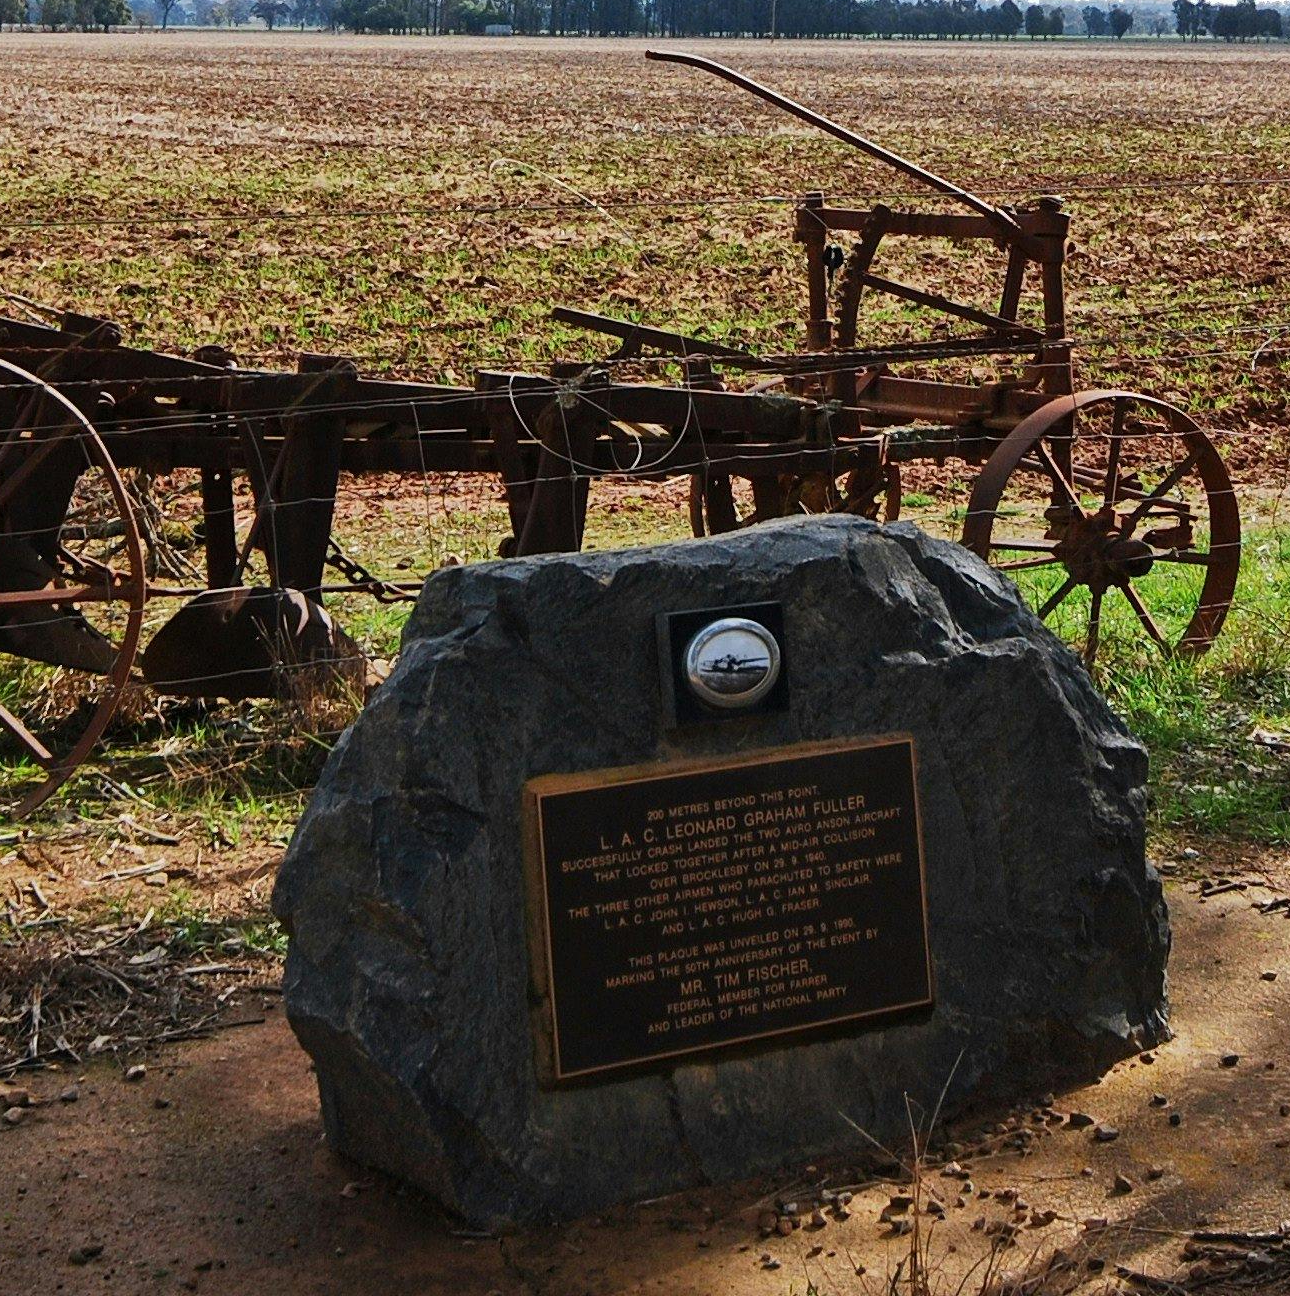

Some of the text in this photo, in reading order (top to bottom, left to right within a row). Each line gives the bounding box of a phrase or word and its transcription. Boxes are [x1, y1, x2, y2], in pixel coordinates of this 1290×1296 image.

[647, 810, 664, 820] 200
[761, 791, 783, 802] THIS
[666, 816, 736, 839] LEONARD
[744, 805, 805, 826] GRAHAM
[814, 795, 865, 815] FULLER
[562, 850, 642, 872] SUCCESSFULLY
[648, 844, 682, 858] CRASH
[688, 836, 728, 851] LANDED
[734, 832, 753, 843] THE
[759, 828, 780, 839] TWO
[817, 817, 850, 830] ANSON
[855, 808, 900, 824] AIRCRAFT
[595, 870, 621, 882] THAT
[627, 862, 668, 877] LOCKED
[674, 852, 727, 869] TOGETHER
[733, 846, 764, 859] AFTER
[781, 837, 818, 851] MID-AIR
[824, 828, 875, 844] COLLISION
[569, 907, 589, 918] THE
[595, 900, 629, 914] THREE
[635, 894, 669, 907] OTHER
[674, 886, 713, 900] AIRMEN
[719, 881, 742, 893] WHO
[748, 869, 813, 888] PARACHUTED
[836, 859, 870, 872] SAFETY
[876, 854, 902, 865] WERE
[650, 876, 677, 889] OVER
[683, 864, 749, 883] BROCKLESBY
[650, 908, 678, 921] JOHN
[788, 886, 805, 897] IAN
[662, 923, 683, 935] AND
[732, 909, 761, 922] HUGH
[606, 971, 654, 988] MARKING
[660, 966, 679, 977] THE
[714, 947, 783, 967] ANNIVERSARY
[807, 939, 826, 950] THE
[831, 932, 861, 945] EVENT
[629, 955, 652, 968] THIS
[658, 946, 698, 962] PLAQUE
[704, 941, 725, 954] WAS
[731, 932, 779, 949] UNVEILED
[667, 974, 827, 1013] FEDERAL MEMBER FOR FARRER
[714, 972, 740, 989] TIM
[648, 1021, 670, 1034] AND
[675, 1013, 714, 1028] LEADER
[739, 1004, 758, 1015] THE
[763, 994, 811, 1011] NATIONAL
[817, 986, 847, 1000] PARTY
